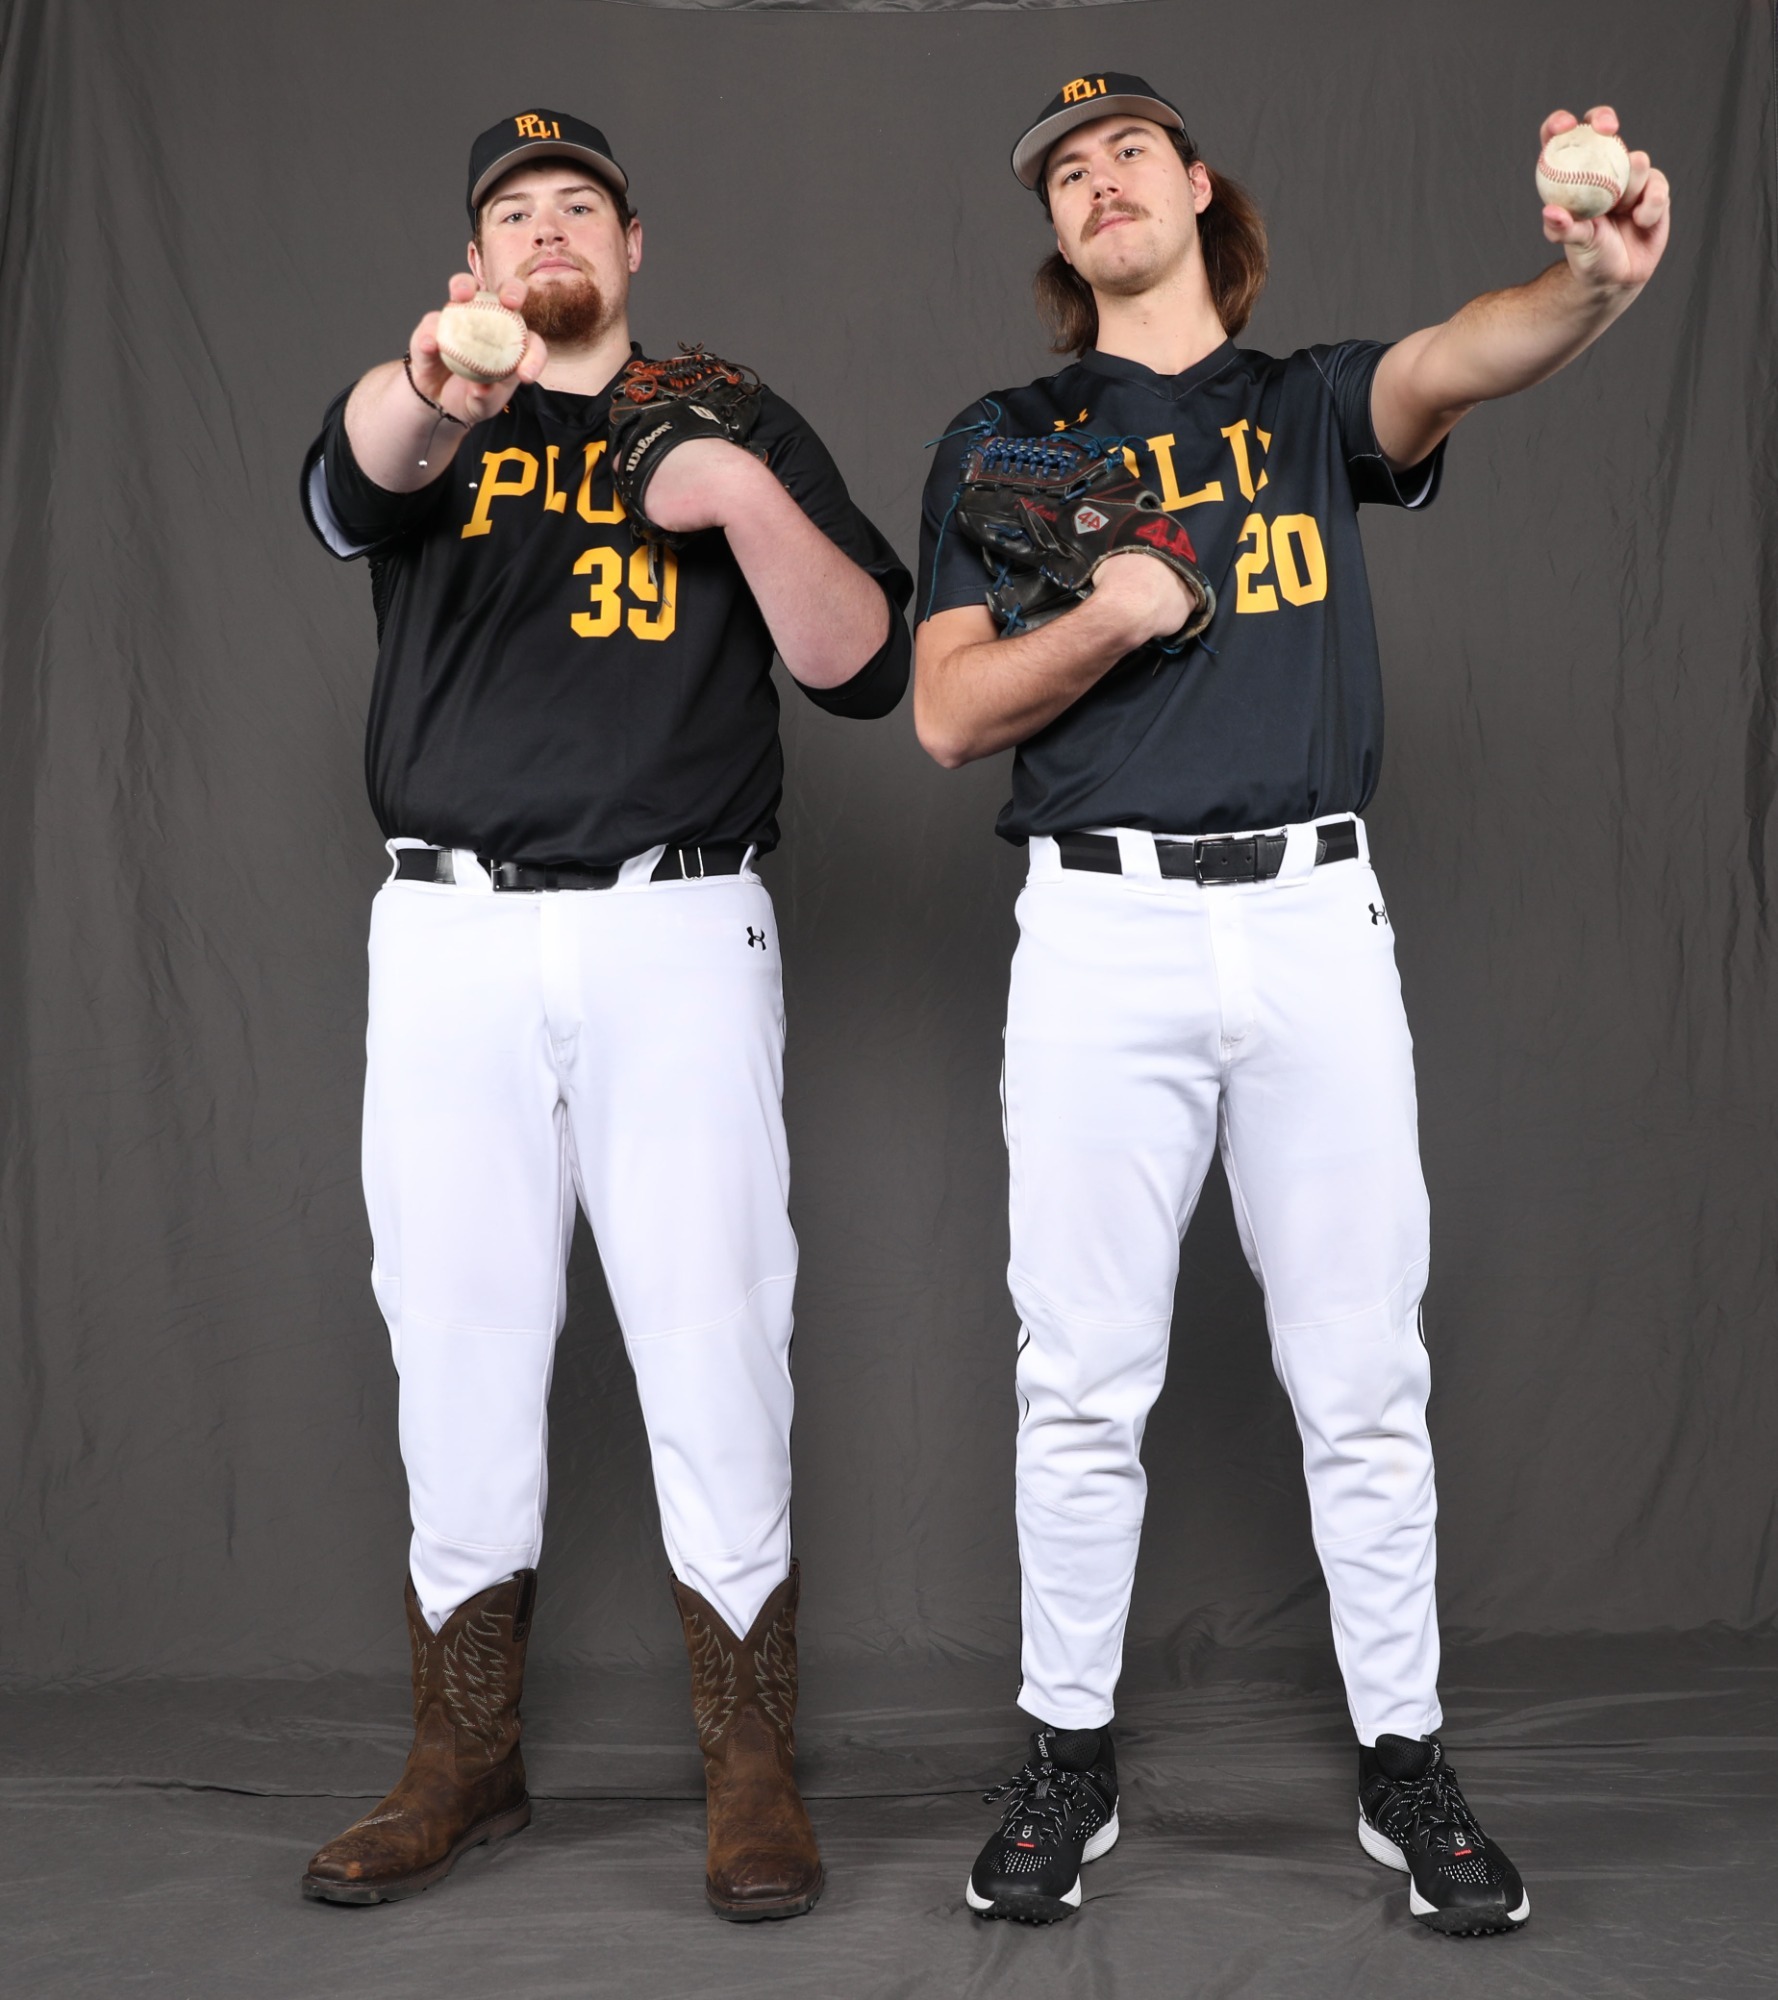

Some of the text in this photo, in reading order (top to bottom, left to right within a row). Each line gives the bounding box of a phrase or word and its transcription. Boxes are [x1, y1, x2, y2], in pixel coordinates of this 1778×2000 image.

[626, 421, 673, 472] Wilson
[570, 545, 678, 642] 39
[1235, 512, 1328, 614] 20
